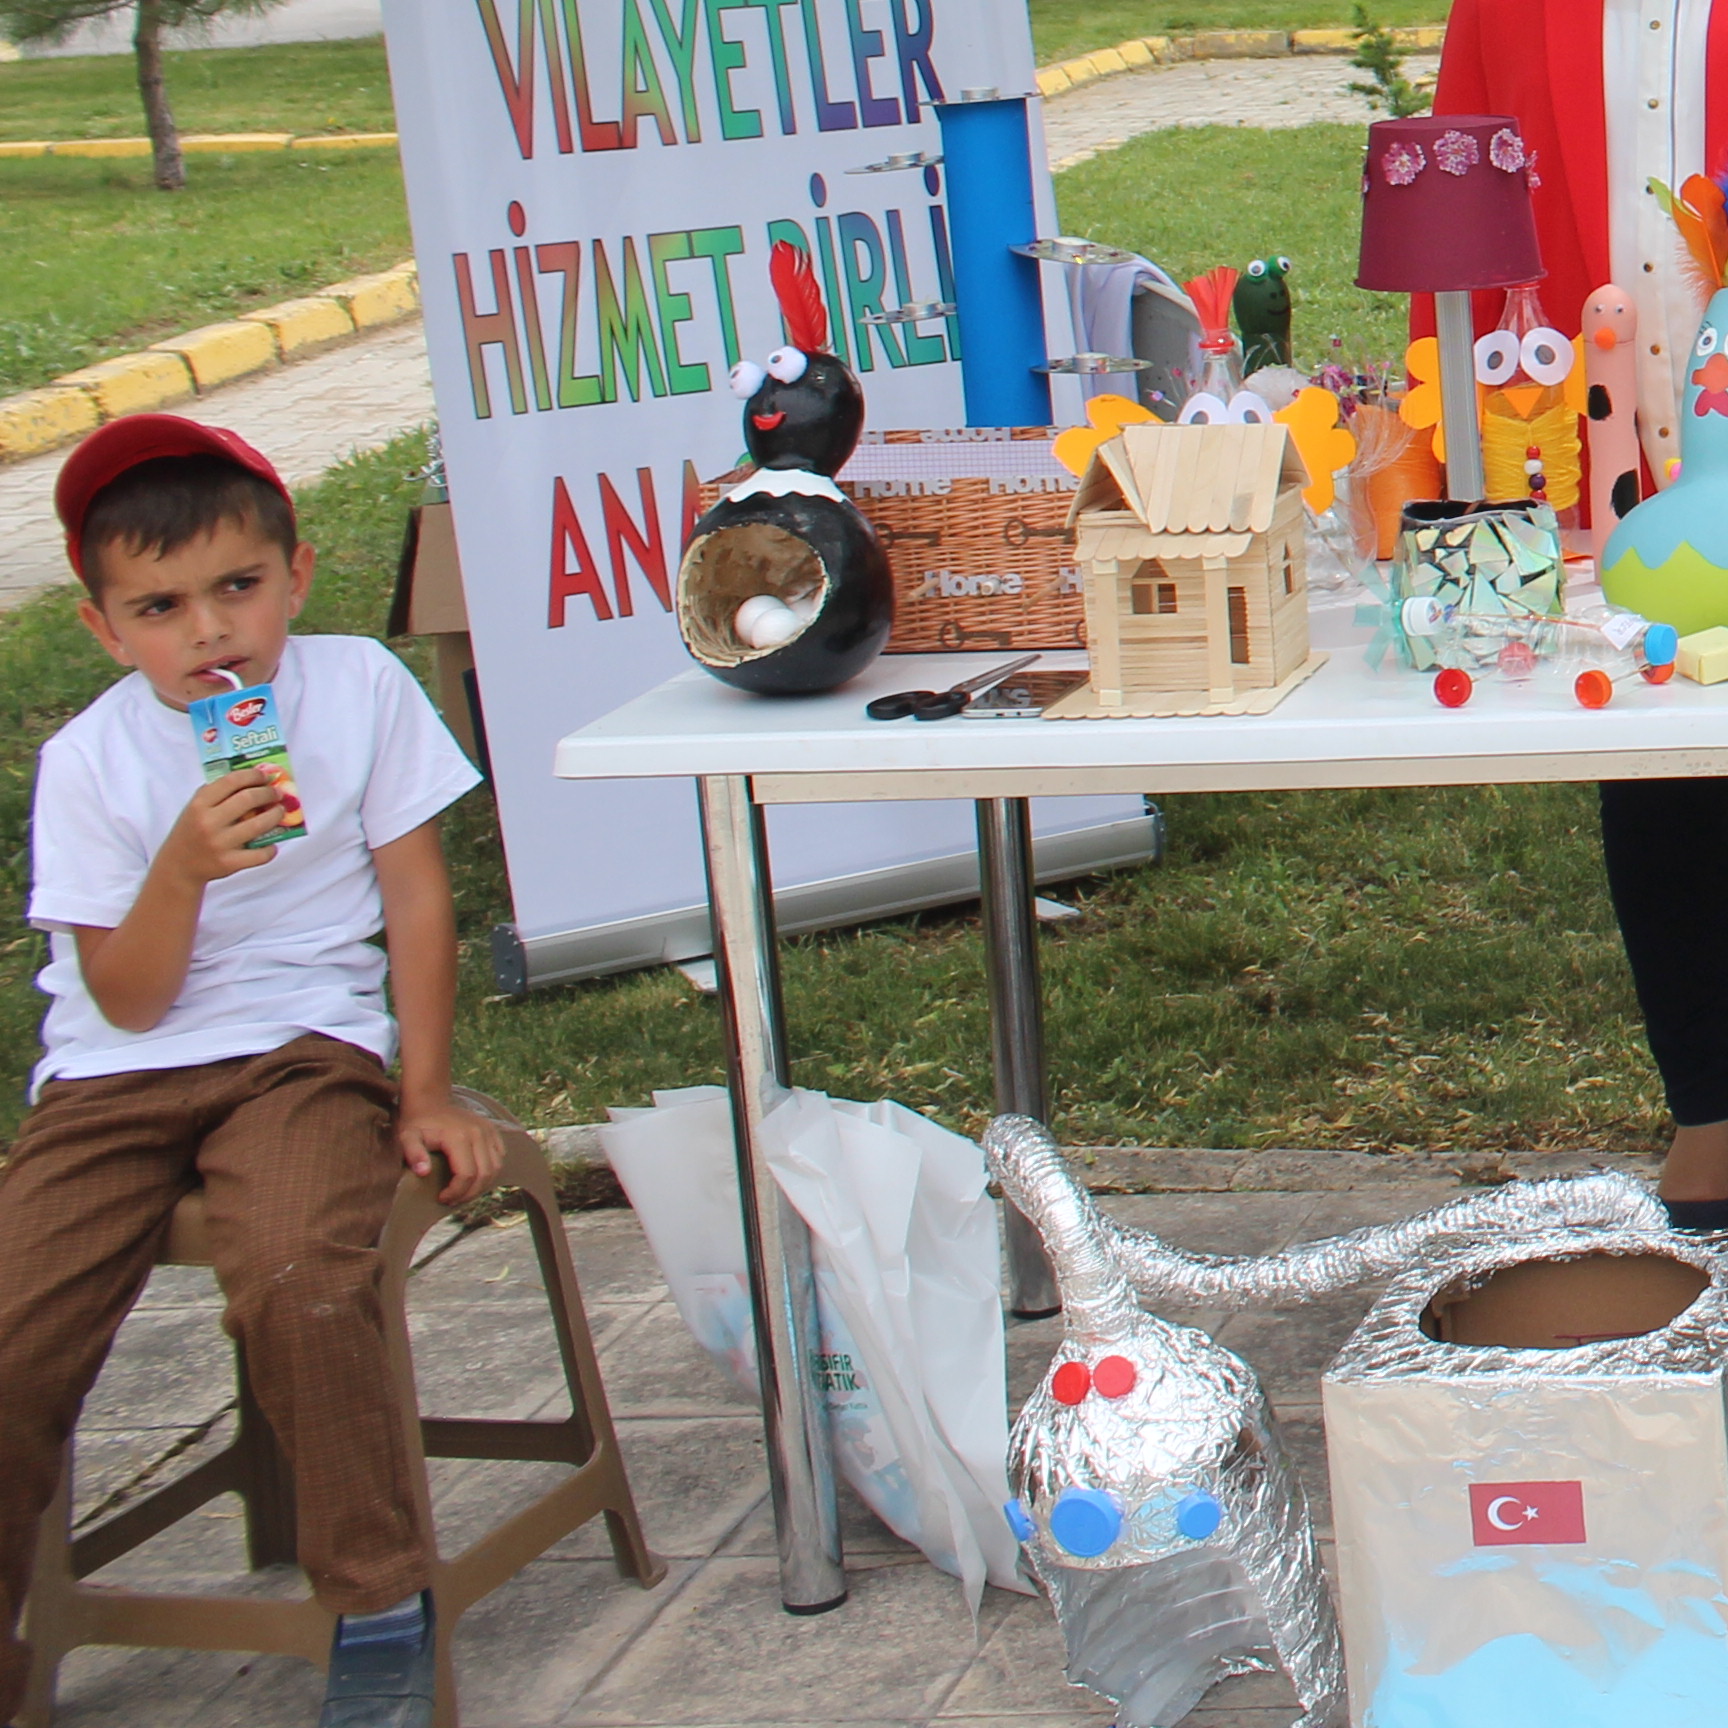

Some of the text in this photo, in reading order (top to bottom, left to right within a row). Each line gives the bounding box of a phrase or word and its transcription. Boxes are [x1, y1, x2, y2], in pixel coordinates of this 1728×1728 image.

[452, 200, 745, 421] HİZMET
[923, 569, 1024, 598] Home
[231, 725, 279, 752] Şeftali
